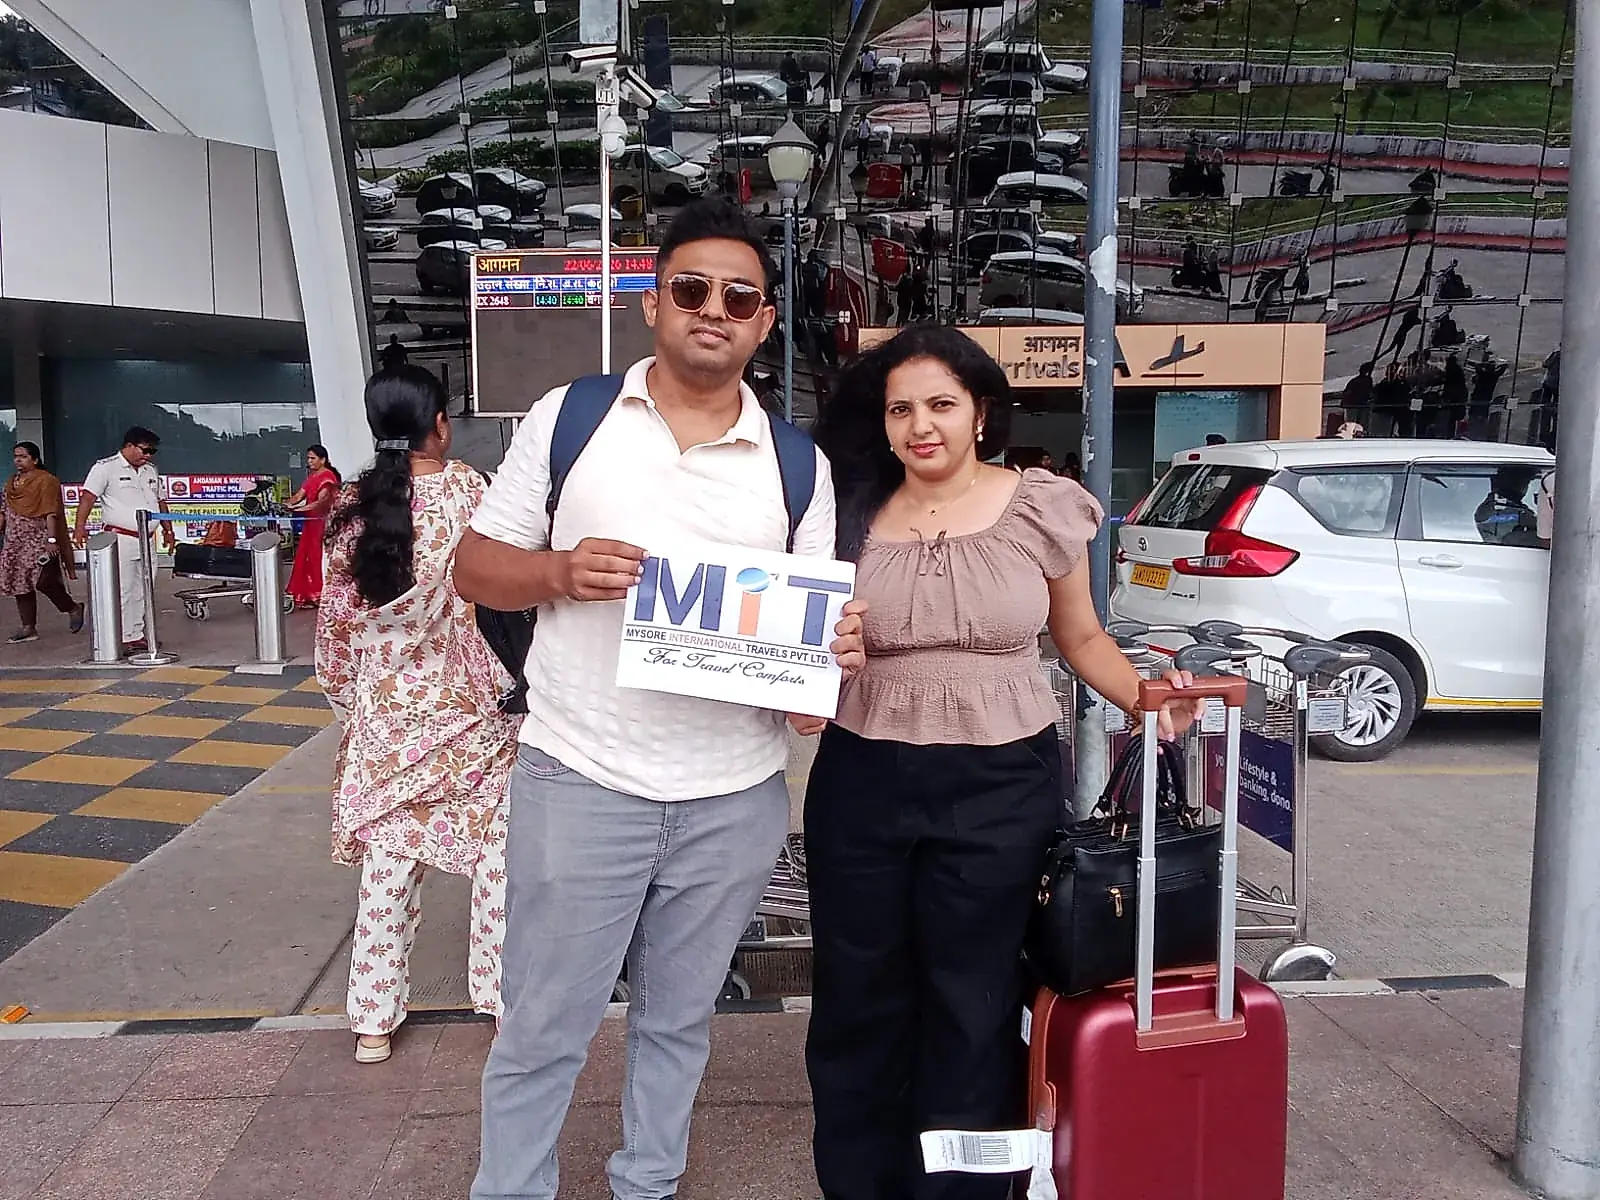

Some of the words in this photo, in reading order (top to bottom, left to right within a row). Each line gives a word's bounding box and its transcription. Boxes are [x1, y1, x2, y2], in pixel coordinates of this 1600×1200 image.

[479, 259, 520, 272] आगमन
[1024, 336, 1081, 353] आगमन
[1001, 354, 1081, 379] rrivals
[626, 628, 667, 640] MYSORE
[669, 633, 744, 653] INTERNATIONAL
[746, 644, 788, 659] TRAVELS
[790, 651, 809, 661] PVT
[811, 655, 831, 665] LTD.
[643, 647, 680, 666] For
[683, 652, 738, 674] Travel
[739, 661, 805, 685] Comforts
[1240, 757, 1270, 782] Lifestyle
[1270, 771, 1277, 786] &
[1240, 772, 1270, 802] banking,
